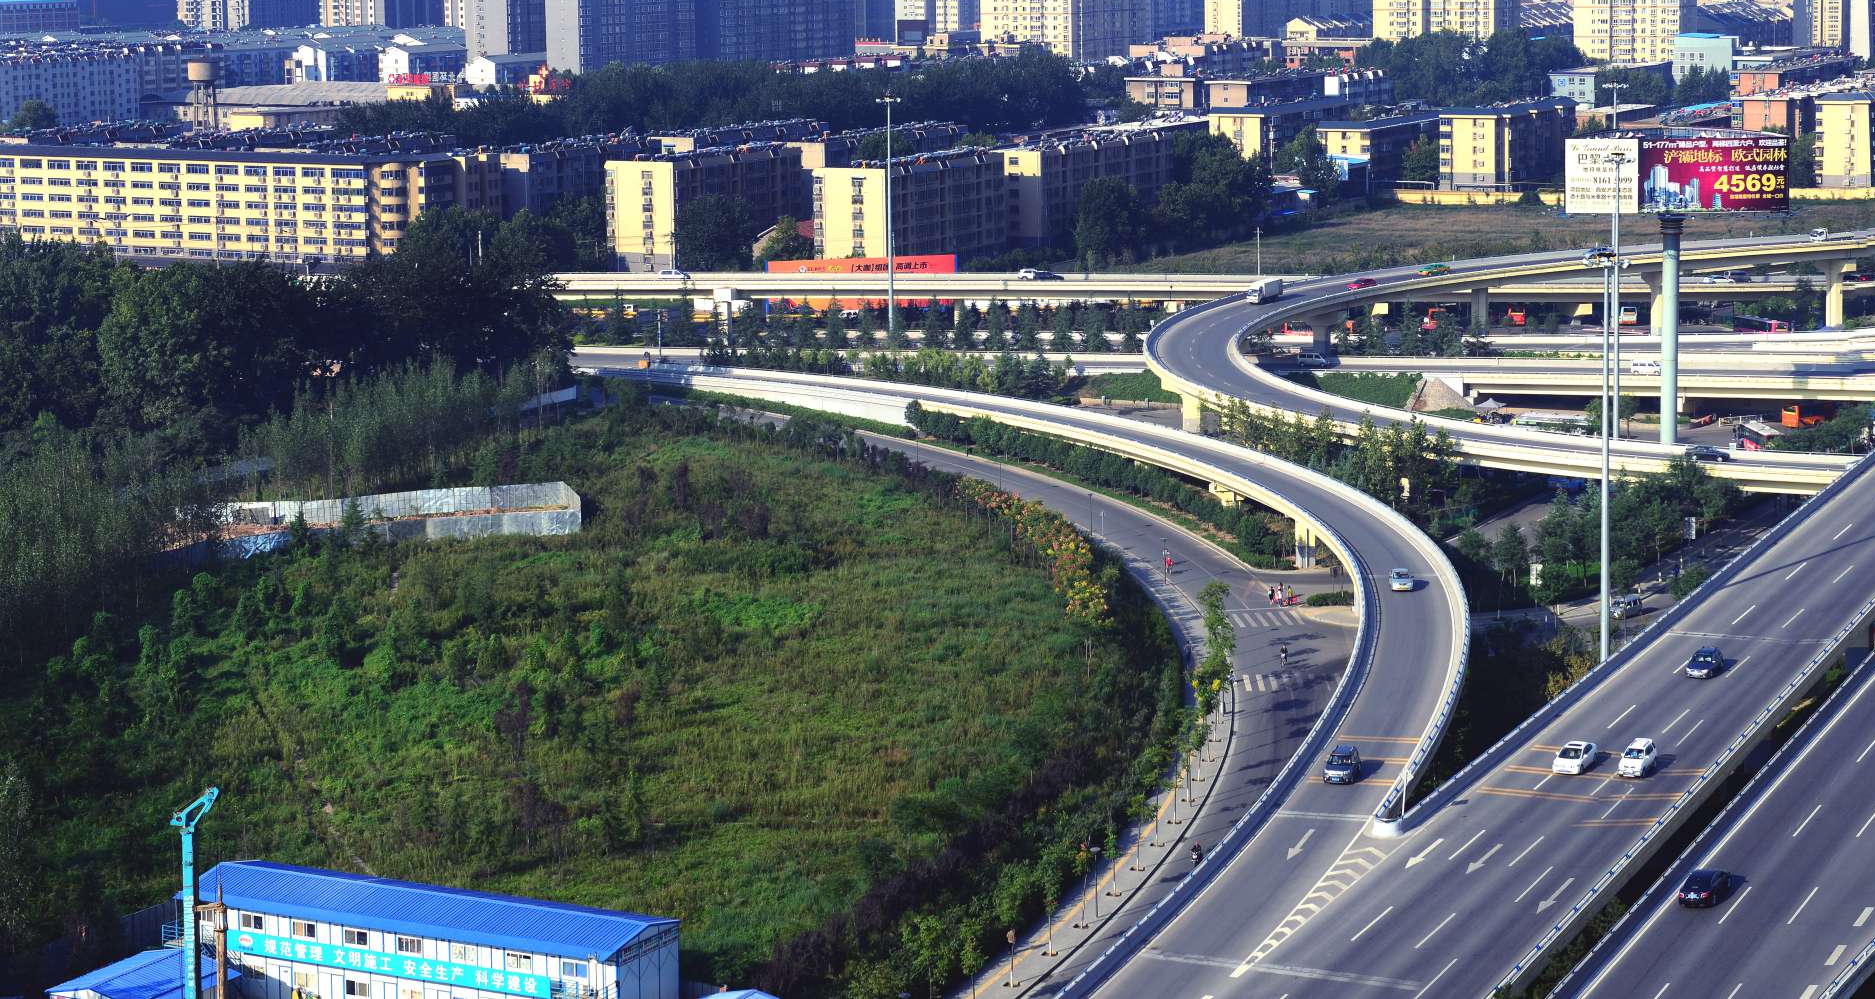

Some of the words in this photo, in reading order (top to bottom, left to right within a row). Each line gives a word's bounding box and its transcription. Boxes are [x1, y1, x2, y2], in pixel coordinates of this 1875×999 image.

[1731, 147, 1788, 162] 欧式园林
[183, 895, 195, 942] SUNWARD
[263, 938, 324, 962] 规范管理
[333, 947, 394, 972] 文明施工
[403, 959, 465, 982] 安全生产
[474, 969, 538, 994] 科学建设
